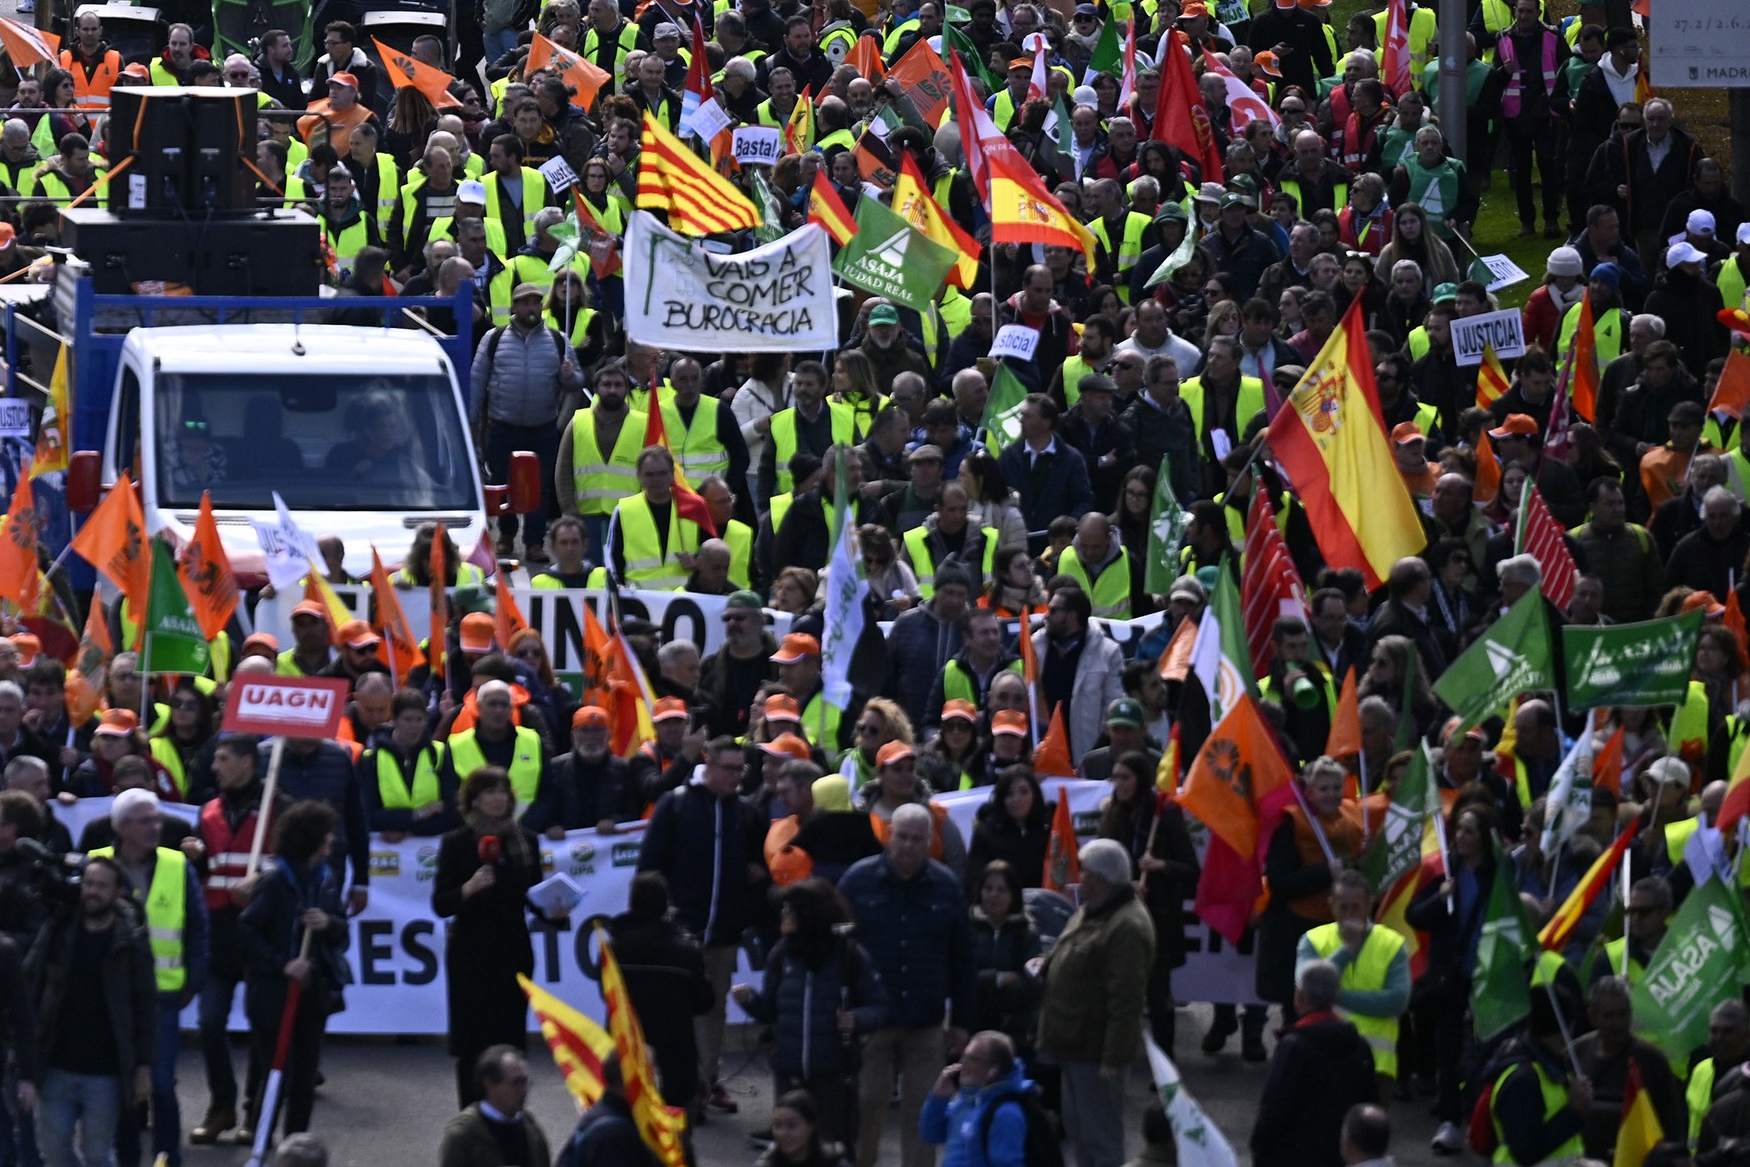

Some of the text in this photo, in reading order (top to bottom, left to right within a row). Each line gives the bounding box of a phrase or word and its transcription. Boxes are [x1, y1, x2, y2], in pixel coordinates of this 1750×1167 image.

[736, 136, 778, 158] Basta!
[704, 244, 798, 281] VAIS A
[855, 255, 905, 285] ASAJA
[705, 266, 815, 308] COMER
[842, 263, 914, 302] IUDAD REAL
[662, 299, 814, 336] BUROCRACIA
[1454, 317, 1523, 356] ¡JUSTICIA!
[245, 687, 328, 709] UAGN
[569, 864, 596, 877] UPA
